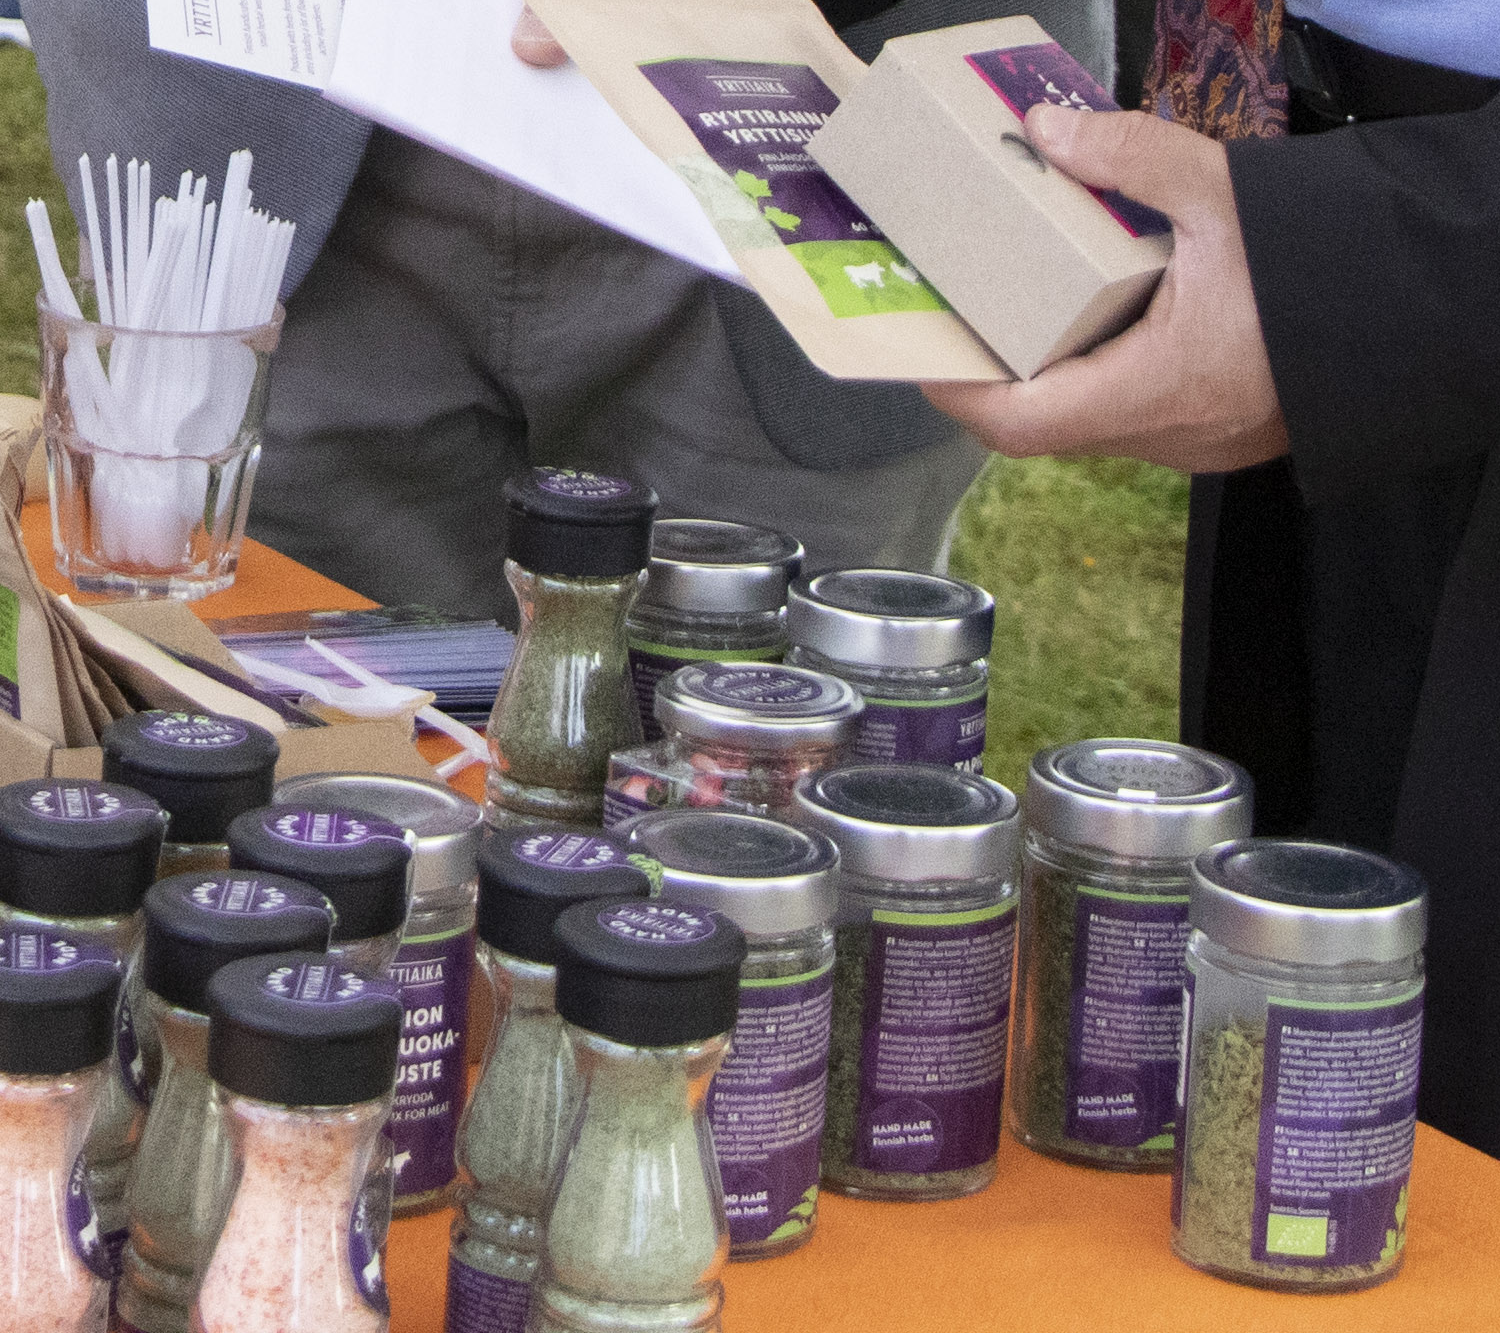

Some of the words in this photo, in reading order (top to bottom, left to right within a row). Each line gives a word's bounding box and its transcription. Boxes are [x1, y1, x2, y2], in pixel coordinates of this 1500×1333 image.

[713, 80, 790, 93] YRTTIAIKA
[388, 964, 443, 983] TTIAIKA
[400, 1029, 460, 1056] UOKA-
[1077, 1096, 1104, 1104] HAND
[1106, 1093, 1134, 1103] MADE
[405, 1108, 426, 1120] FOR
[428, 1101, 449, 1116] MEAT
[727, 1113, 739, 1121] SE
[1078, 1108, 1109, 1117] Finnish
[1111, 1107, 1137, 1115] herbs
[873, 1123, 900, 1133] HAND
[903, 1120, 932, 1131] MADE
[873, 1135, 906, 1146] Finnish
[908, 1133, 934, 1144] herbs
[740, 1191, 768, 1203] MADE
[743, 1205, 768, 1215] herbs
